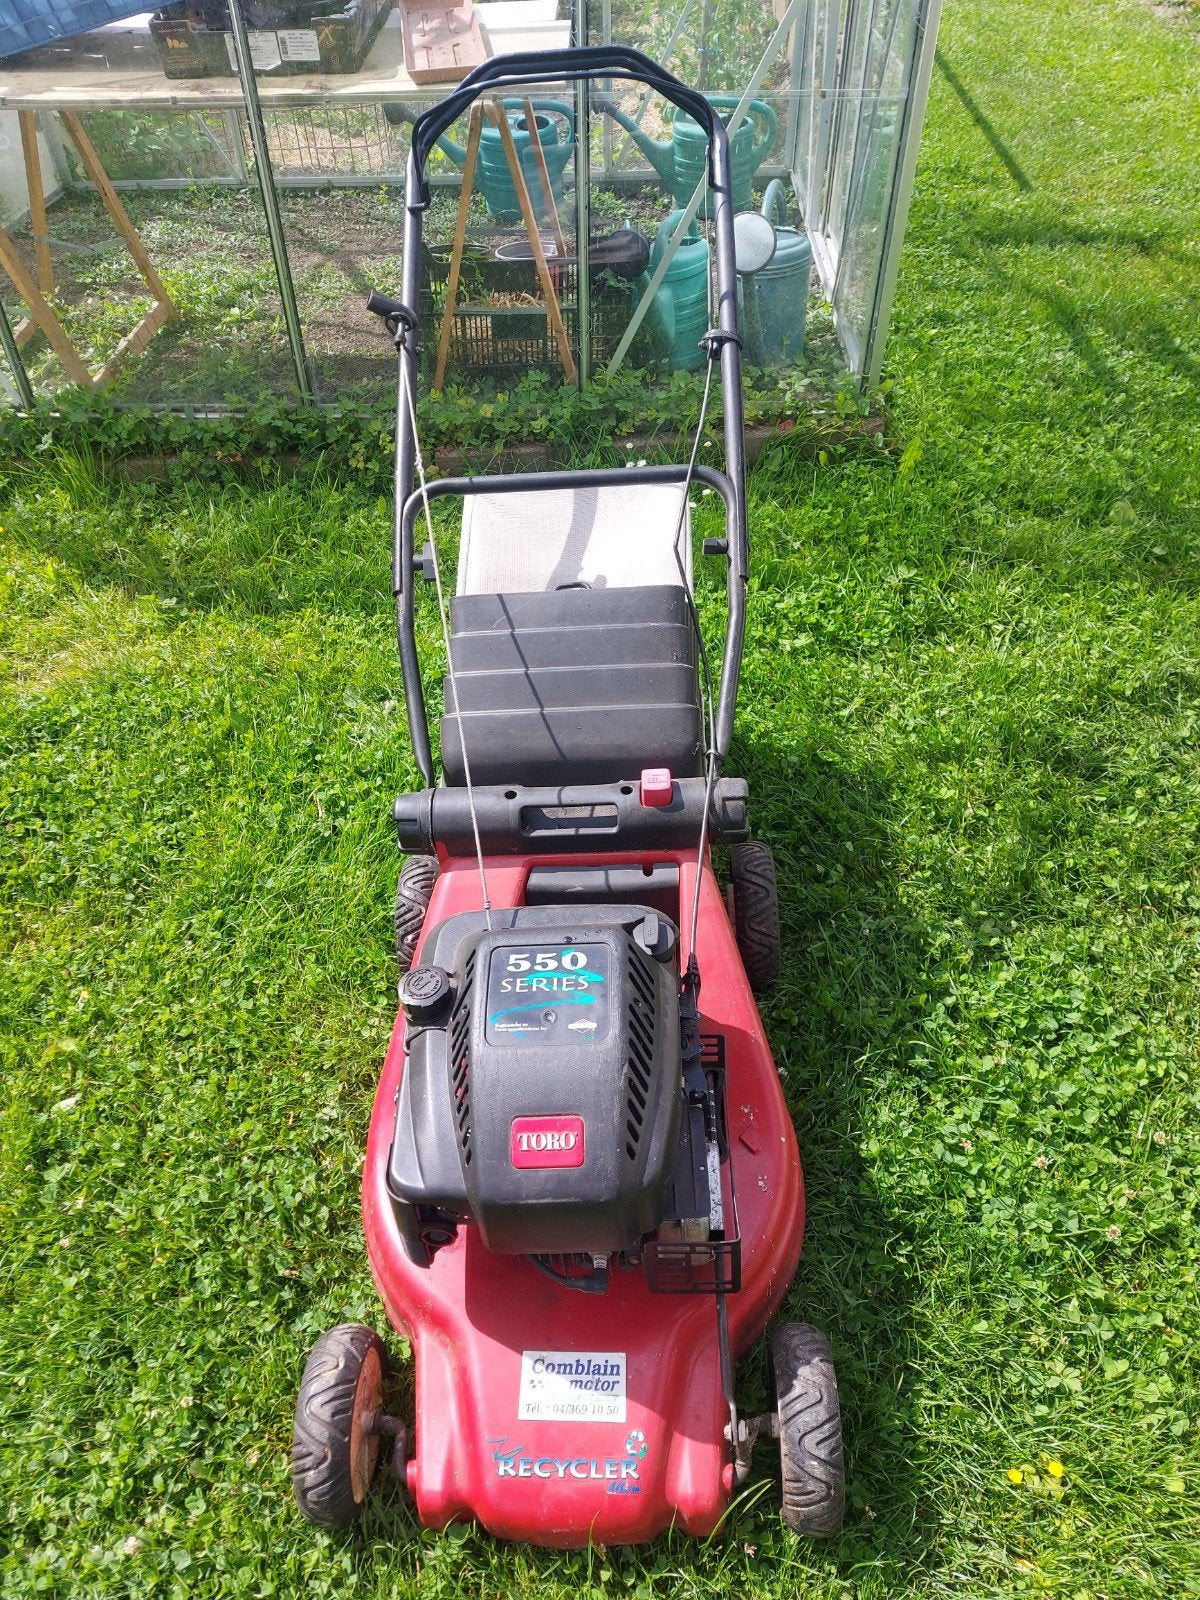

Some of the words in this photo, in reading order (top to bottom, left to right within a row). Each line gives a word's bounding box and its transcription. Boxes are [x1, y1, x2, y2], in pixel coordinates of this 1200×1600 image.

[507, 951, 588, 972] 550
[500, 975, 589, 992] SERIES
[517, 1132, 576, 1151] TORO
[532, 1358, 621, 1377] Comblain
[569, 1377, 620, 1392] motor
[525, 1402, 543, 1414] Tél.
[552, 1403, 588, 1415] 04/369
[591, 1404, 603, 1415] 10
[606, 1404, 620, 1416] 50
[497, 1457, 640, 1480] RECYCLER
